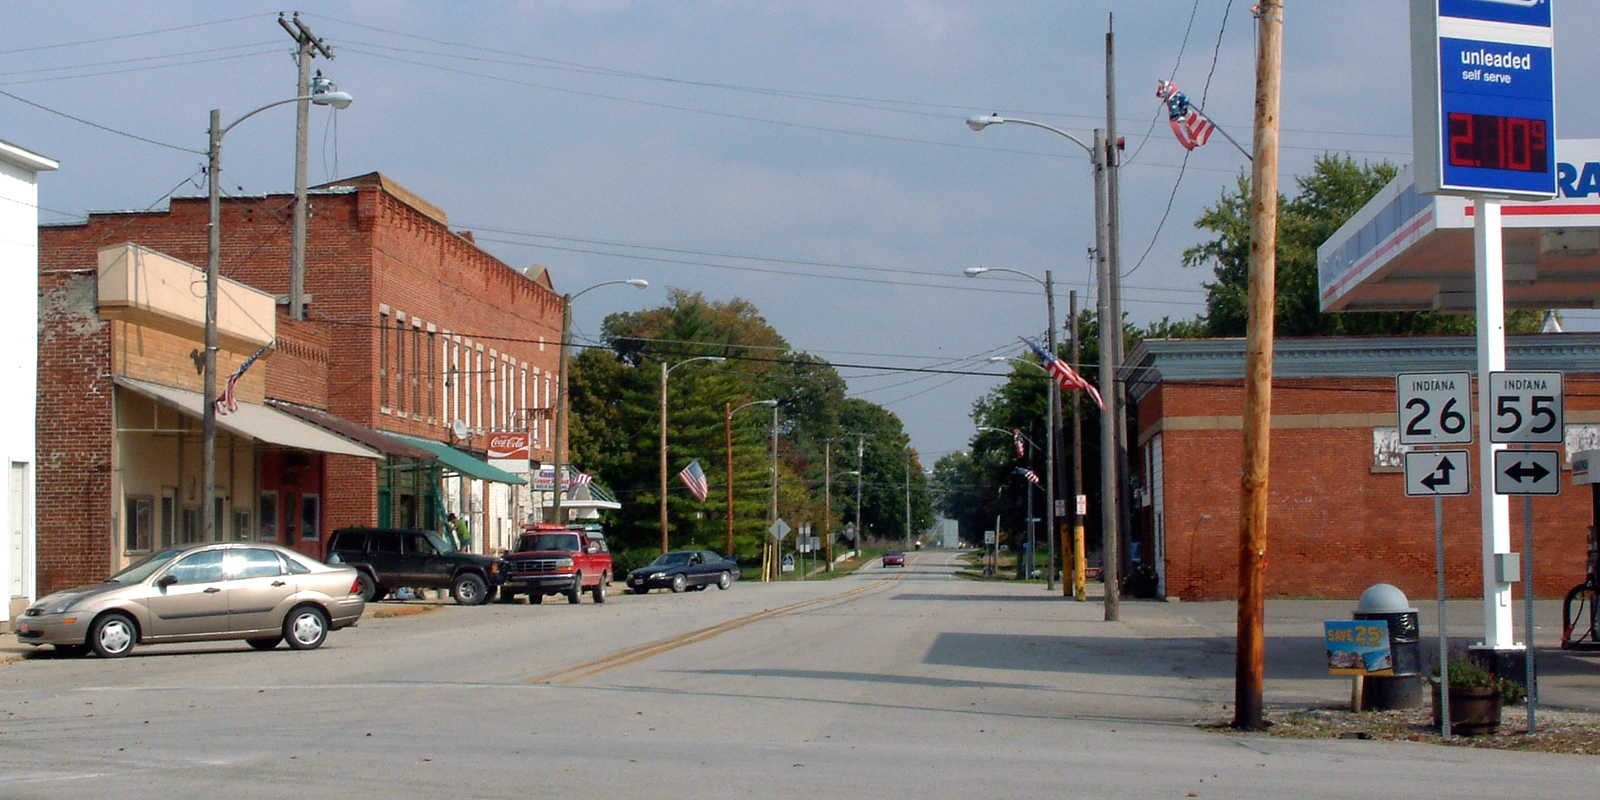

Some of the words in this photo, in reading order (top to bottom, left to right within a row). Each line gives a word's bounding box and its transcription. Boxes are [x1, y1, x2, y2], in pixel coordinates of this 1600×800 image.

[1461, 49, 1531, 70] unleaded
[1462, 70, 1481, 81] self
[1483, 72, 1511, 84] serve
[1412, 380, 1455, 391] INDIANA
[1504, 379, 1547, 390] INDIANA
[1405, 397, 1466, 435] 26
[1496, 395, 1557, 434] 55
[1328, 628, 1353, 642] SAVE
